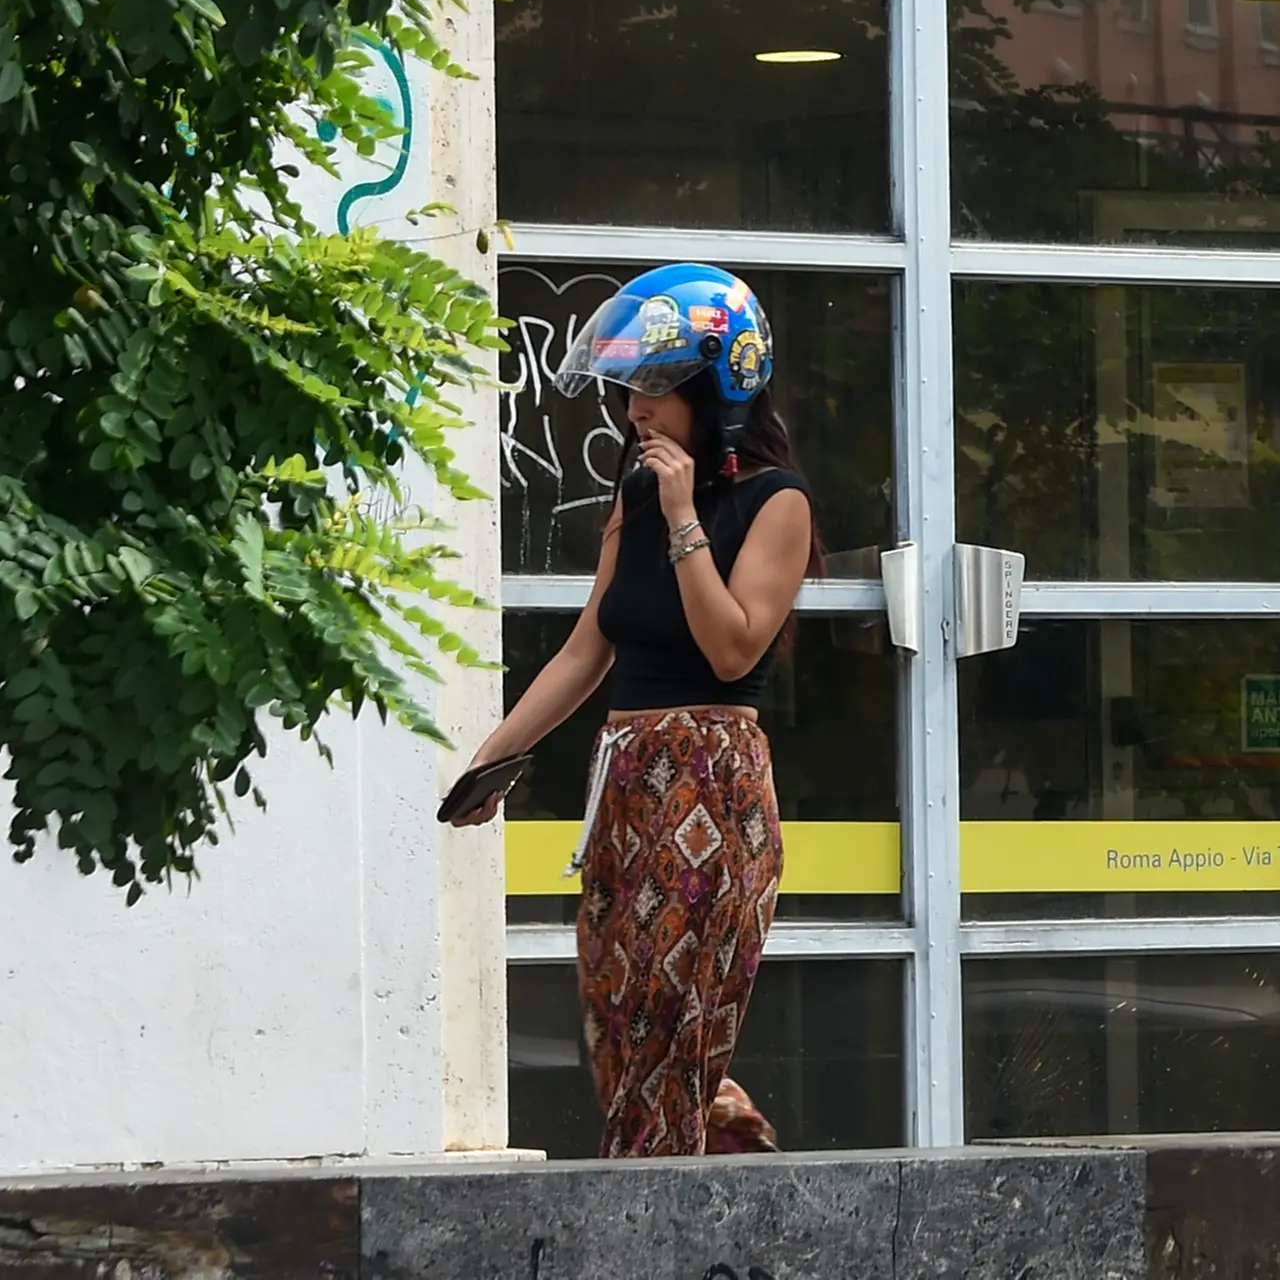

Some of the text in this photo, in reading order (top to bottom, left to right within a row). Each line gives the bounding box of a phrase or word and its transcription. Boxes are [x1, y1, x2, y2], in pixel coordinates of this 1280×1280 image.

[1004, 560, 1014, 639] SPINGERE
[1106, 849, 1162, 869] Roma
[1168, 847, 1225, 872] Appio
[1242, 846, 1272, 866] Via
